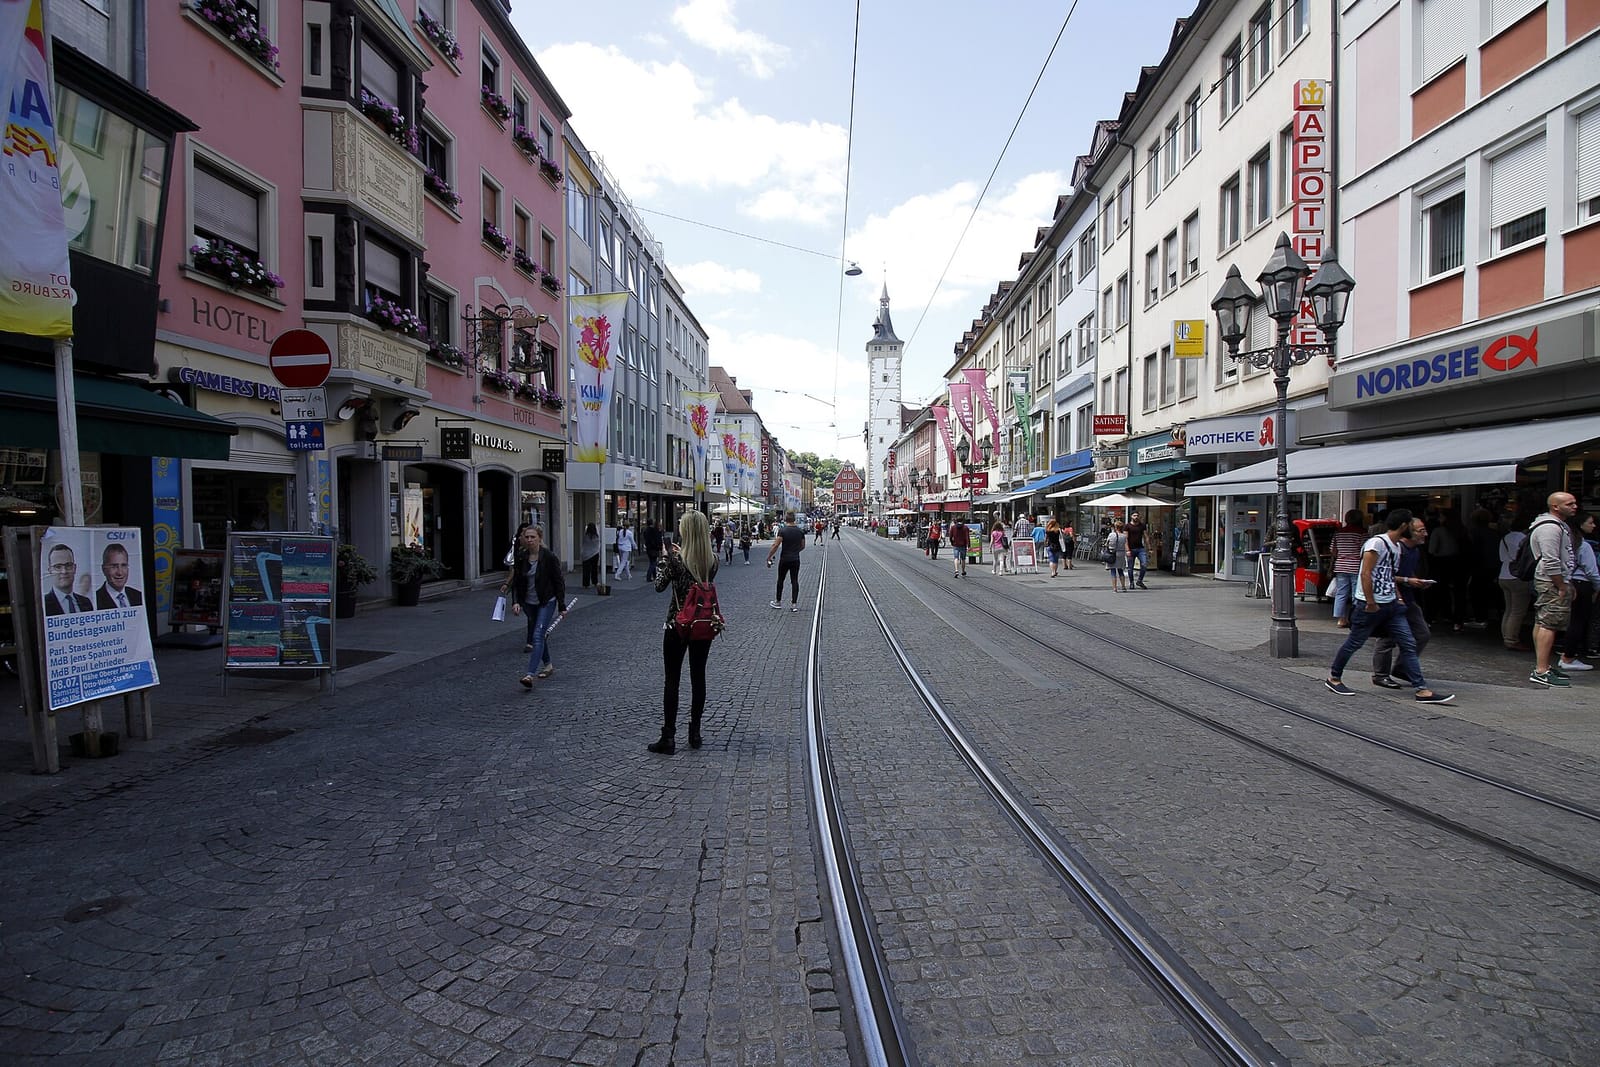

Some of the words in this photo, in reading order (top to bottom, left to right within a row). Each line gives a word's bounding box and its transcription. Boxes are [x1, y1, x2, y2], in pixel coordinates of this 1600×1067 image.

[191, 297, 274, 344] HOTEL
[1356, 345, 1480, 399] NORDSEE
[179, 366, 255, 399] GAMERS
[296, 407, 316, 418] frei
[513, 407, 537, 426] HOTEL
[1094, 416, 1125, 426] SATINEE
[289, 442, 324, 450] toiletten
[1188, 430, 1255, 447] APOTHEKE
[106, 531, 126, 540] CSU
[47, 610, 121, 629] Bürgergespräch
[122, 609, 137, 619] zur
[48, 621, 125, 642] Bundestagswahl
[49, 646, 68, 657] Parl.
[68, 637, 124, 654] Staatssekretär
[50, 656, 69, 667] MdB
[70, 652, 87, 664] Jens
[87, 649, 112, 662] Spahn
[113, 646, 128, 655] und
[51, 667, 69, 679] MdB
[71, 663, 88, 675] Paul
[89, 657, 125, 672] Lehrieder
[98, 667, 119, 678] Oberer
[52, 677, 79, 691] 08.07.
